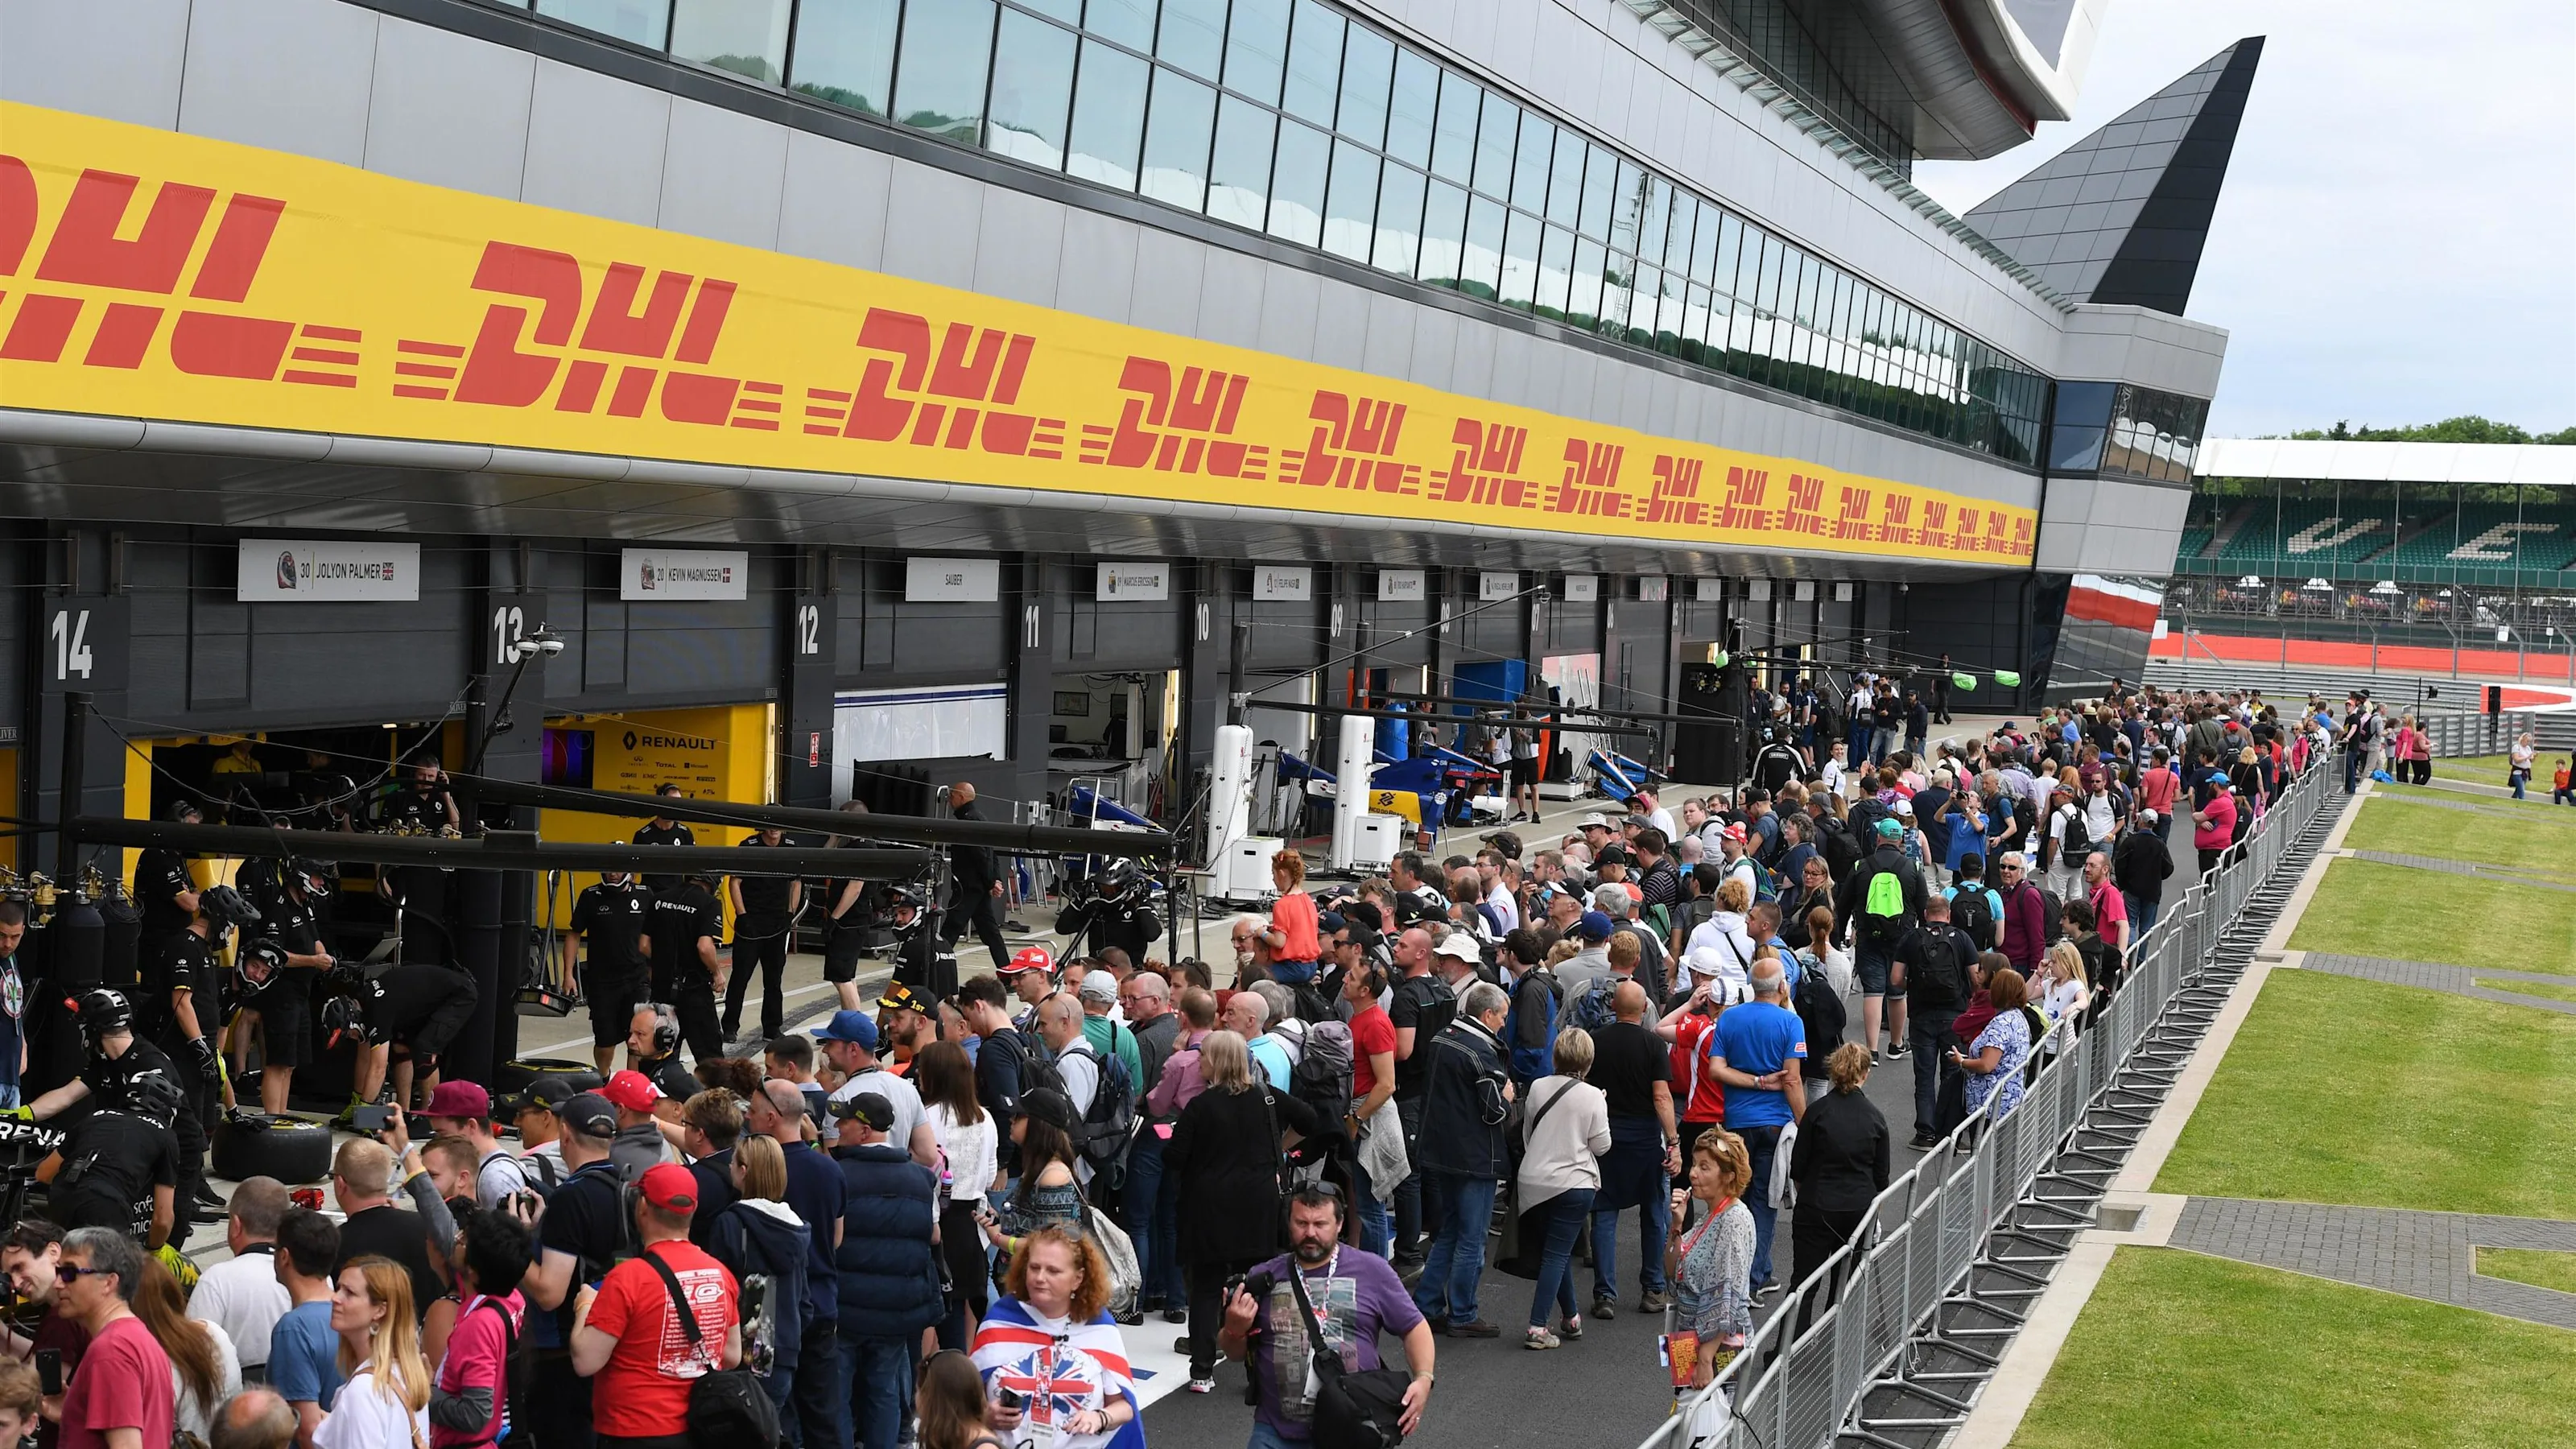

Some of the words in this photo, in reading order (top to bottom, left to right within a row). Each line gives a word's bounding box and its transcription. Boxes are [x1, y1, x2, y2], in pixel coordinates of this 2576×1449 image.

[0, 155, 295, 380] HL
[454, 241, 740, 426] DHL
[844, 308, 1036, 456] DHL
[1107, 357, 1247, 477] DHL
[1299, 390, 1404, 493] DHL
[1444, 419, 1526, 506] DHL
[1557, 438, 1623, 516] DHL
[1646, 456, 1703, 524] DHL
[1720, 467, 1768, 529] DHL
[1783, 475, 1823, 534] DHL
[1835, 487, 1869, 540] DHL
[1880, 494, 1910, 543] DHL
[1920, 501, 1946, 547] DHL
[1955, 508, 1979, 551] DHL
[1984, 511, 2005, 553] DHL
[2013, 517, 2031, 555] DHL
[2446, 523, 2559, 560] E
[300, 563, 310, 579] 30
[316, 563, 347, 579] JOLYON
[349, 563, 381, 580] PALMER
[657, 568, 664, 581] 20
[668, 568, 686, 581] KEVIN
[687, 568, 722, 582] MAGNUSSEN
[945, 574, 963, 585] SAUBER
[799, 605, 819, 654] 12
[1025, 605, 1040, 648] 11
[1196, 603, 1210, 642] 10
[1331, 604, 1343, 638] 09
[1440, 603, 1450, 633] 08
[1531, 604, 1540, 632] 07
[1607, 603, 1614, 629] 06
[52, 609, 93, 679] 14
[642, 736, 718, 750] RENAULT
[661, 902, 697, 914] RENAULT
[910, 1000, 925, 1013] 1ST
